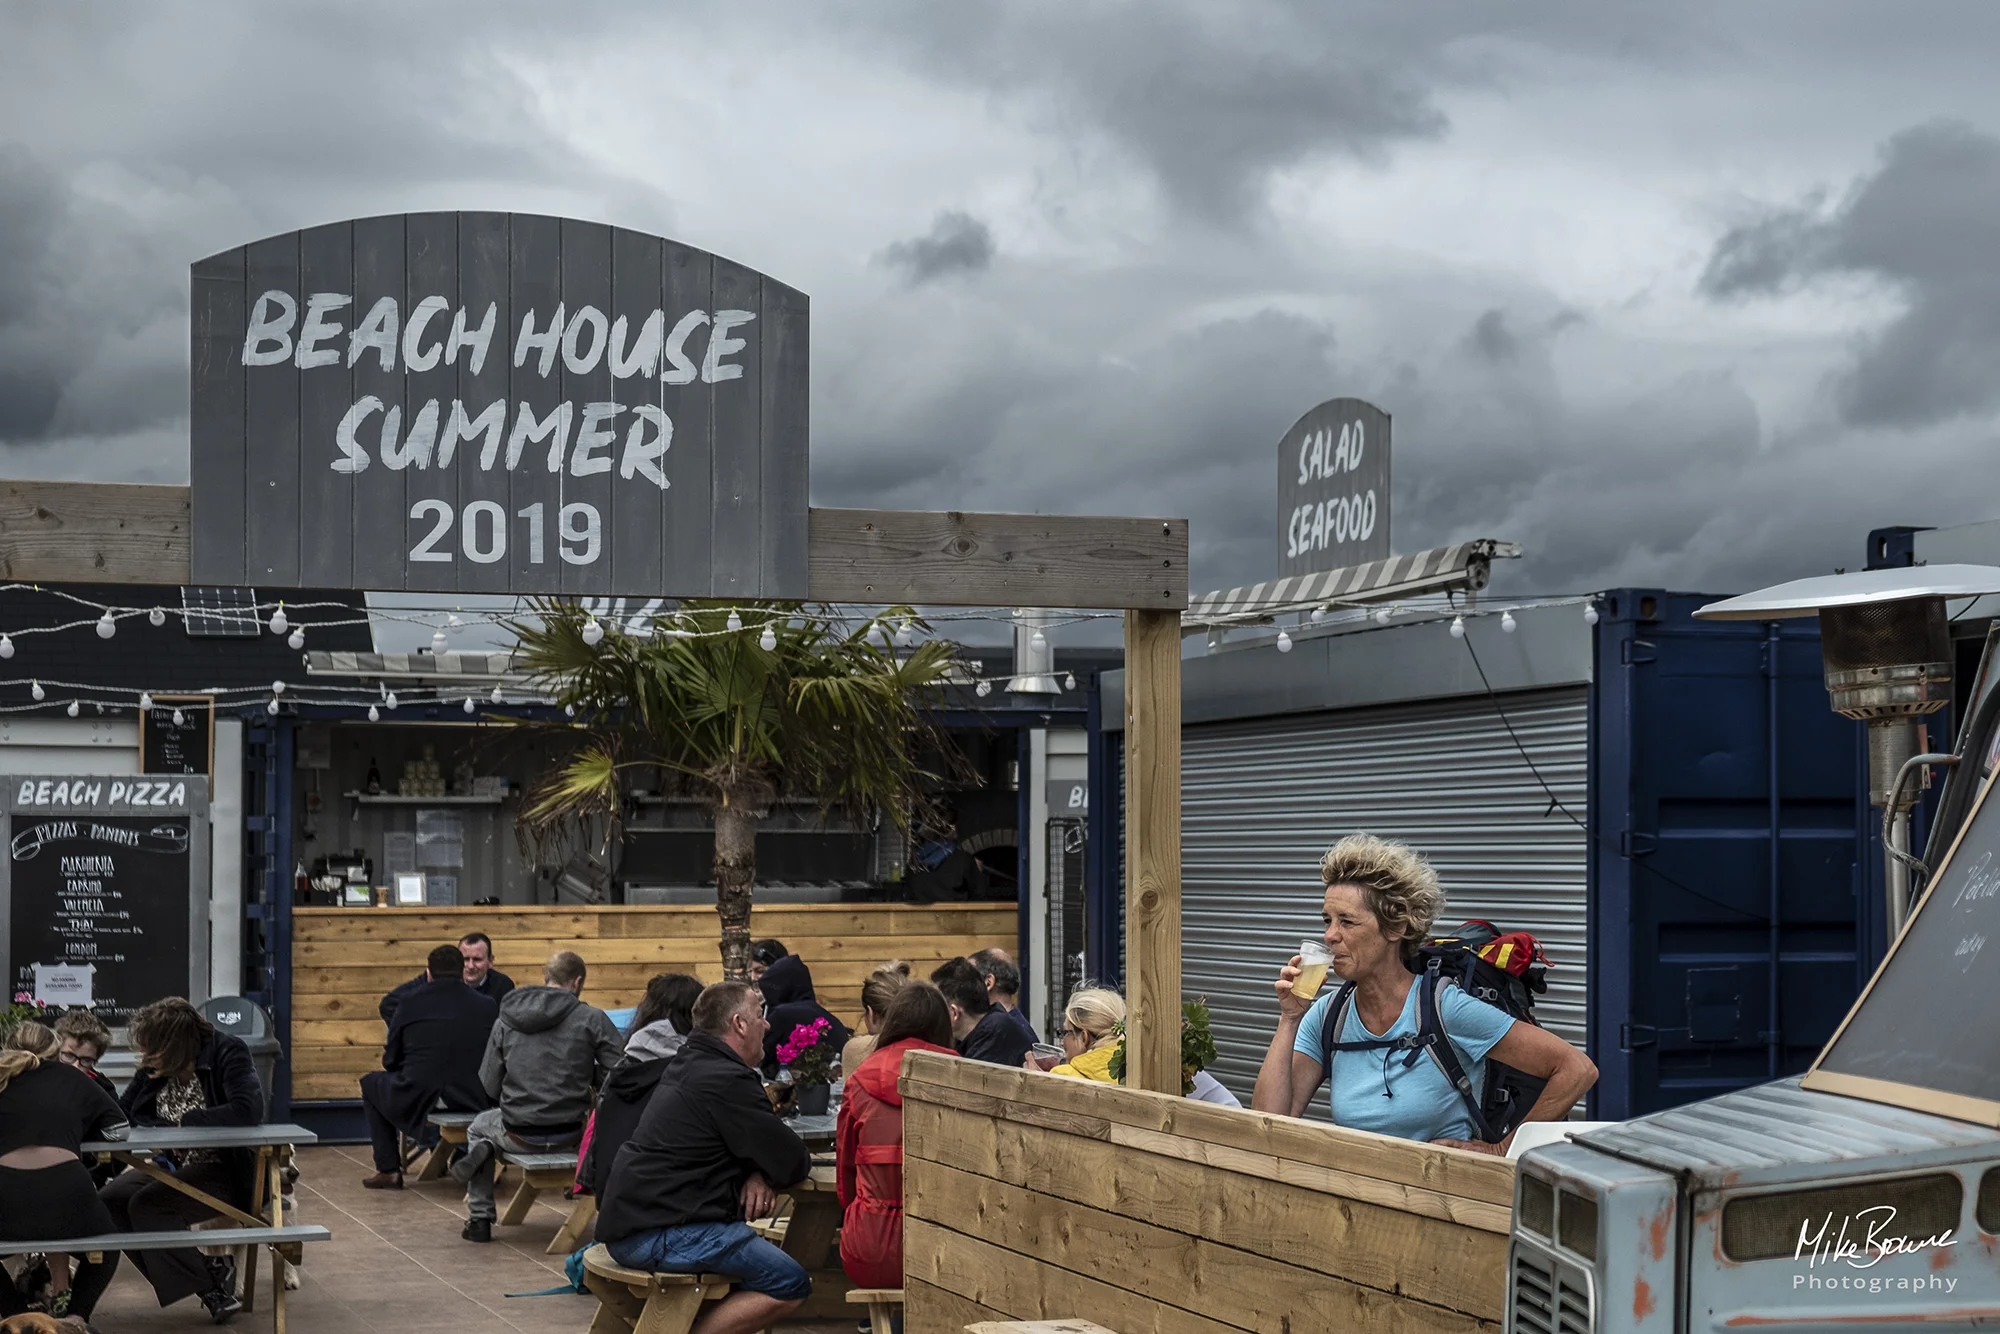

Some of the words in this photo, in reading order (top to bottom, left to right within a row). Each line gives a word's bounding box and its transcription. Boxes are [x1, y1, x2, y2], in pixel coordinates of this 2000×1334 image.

[242, 290, 497, 377] BEACH
[514, 301, 757, 386] HOUSE
[331, 395, 674, 489] SUMMER
[1298, 419, 1364, 485] SALAD
[409, 499, 602, 565] 2019
[1287, 489, 1376, 558] SEAFOOD
[18, 780, 101, 806] BEACH
[108, 781, 186, 807] PIZZA
[1068, 785, 1088, 808] B
